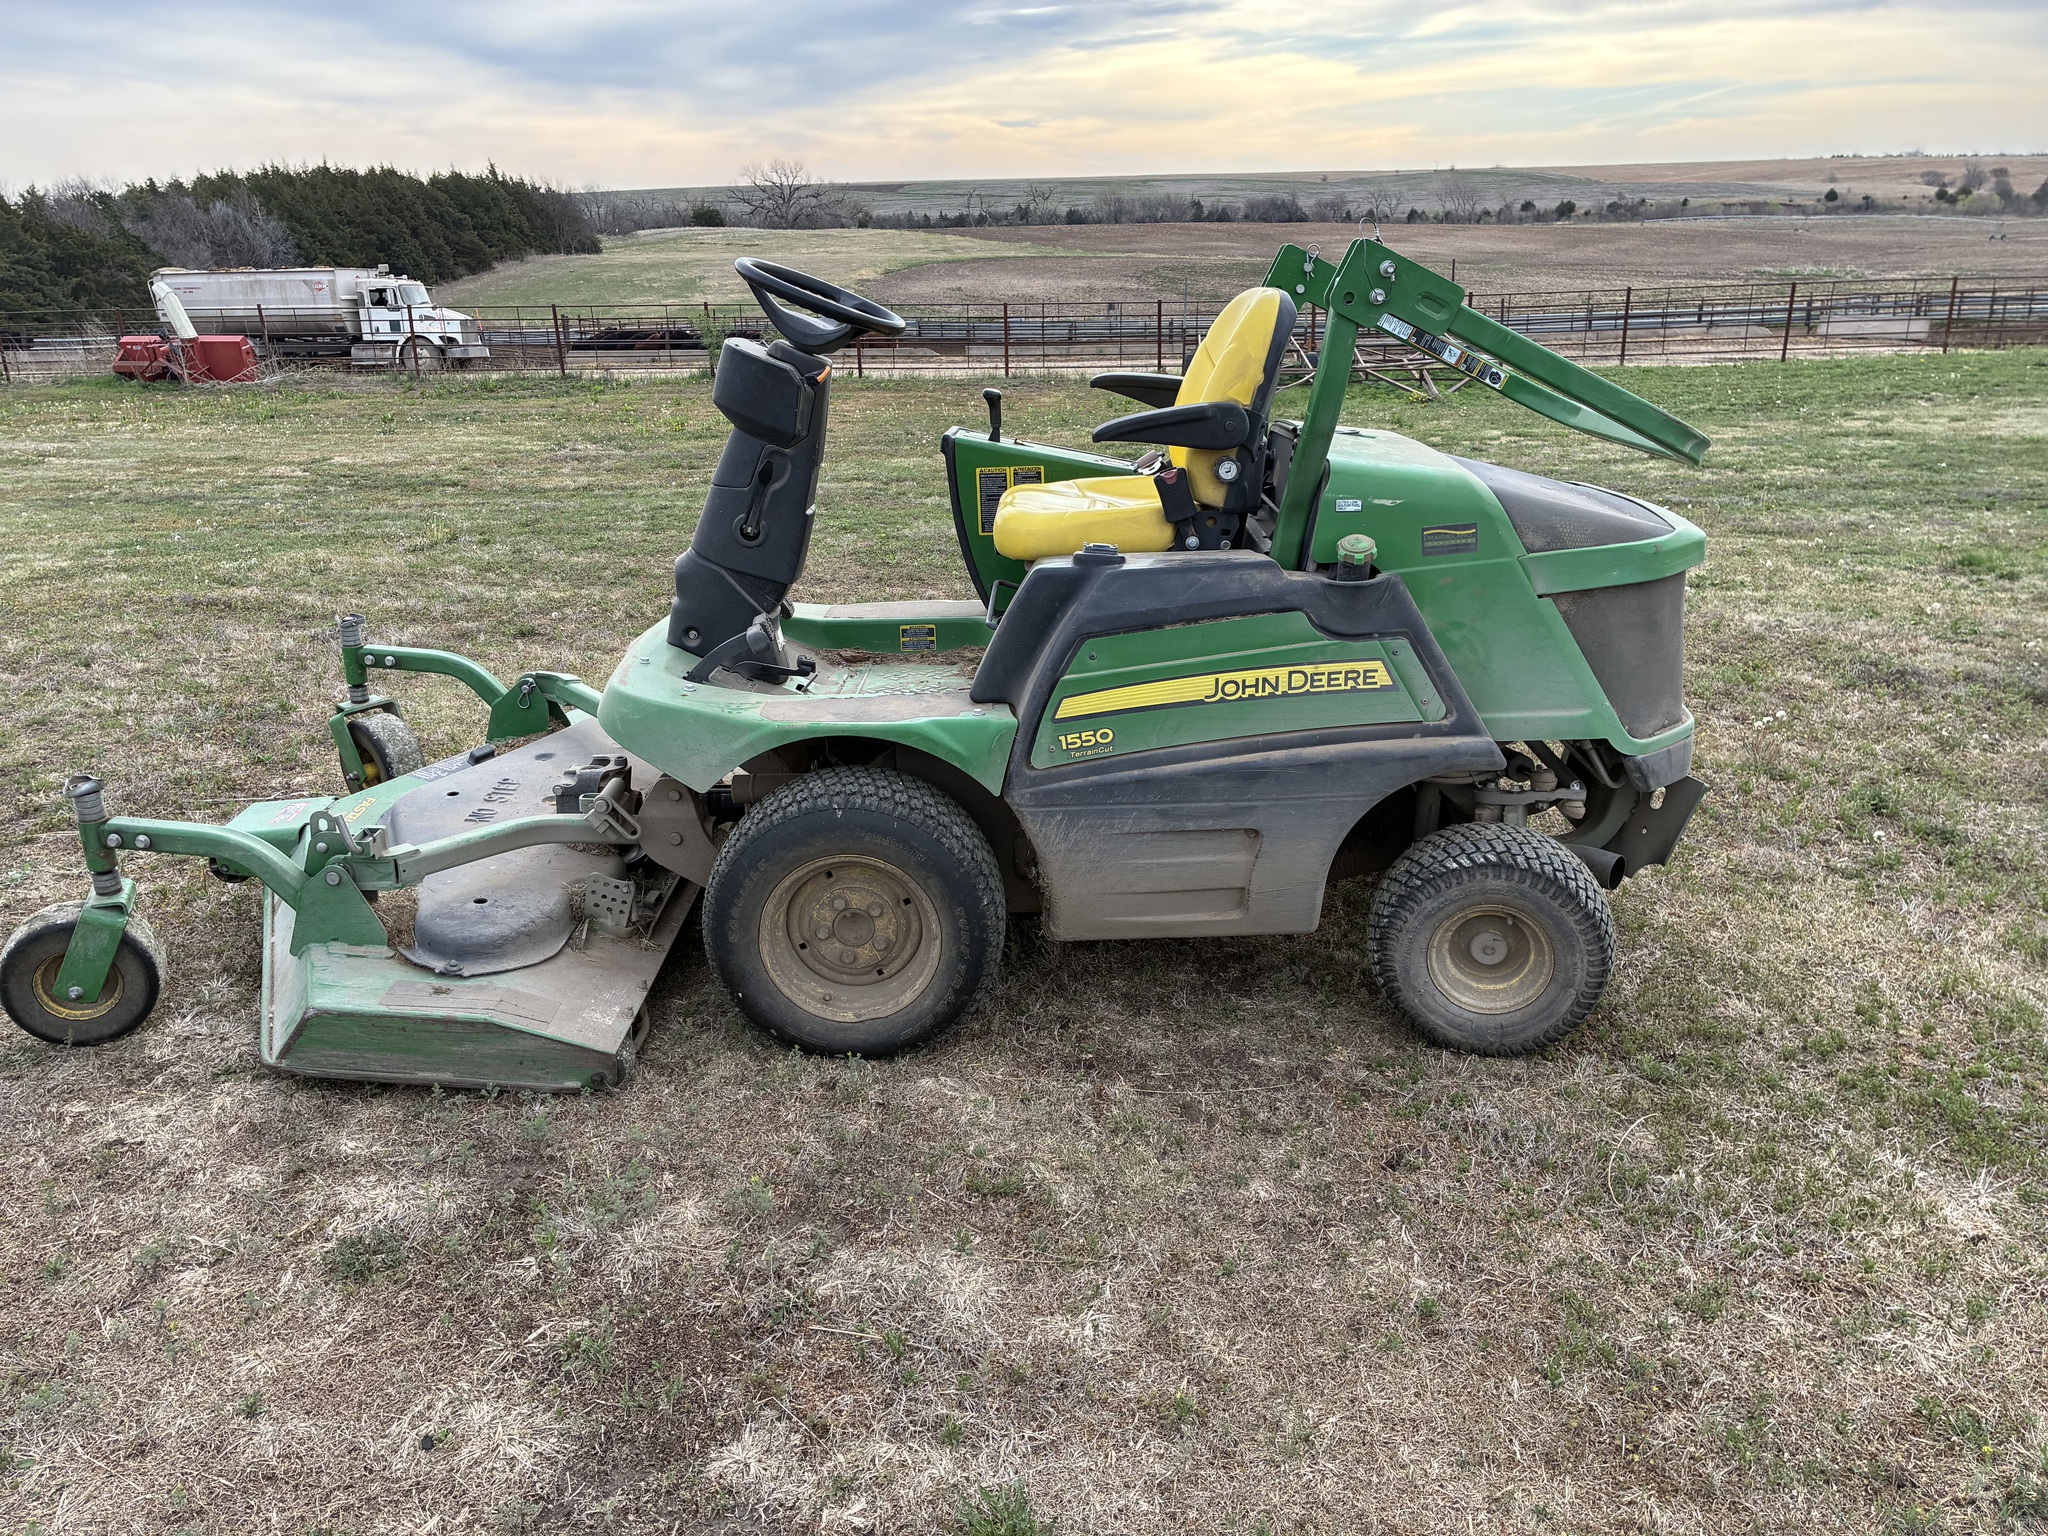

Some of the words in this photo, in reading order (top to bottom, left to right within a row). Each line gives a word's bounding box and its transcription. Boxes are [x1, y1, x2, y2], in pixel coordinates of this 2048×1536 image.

[1204, 676, 1280, 700] JOHN
[1287, 669, 1379, 691] DEERE
[1058, 728, 1114, 750] 1550
[1070, 745, 1114, 758] TerrainCut
[464, 808, 498, 823] NO
[482, 778, 522, 804] STEP
[727, 859, 768, 943] CARLISLE
